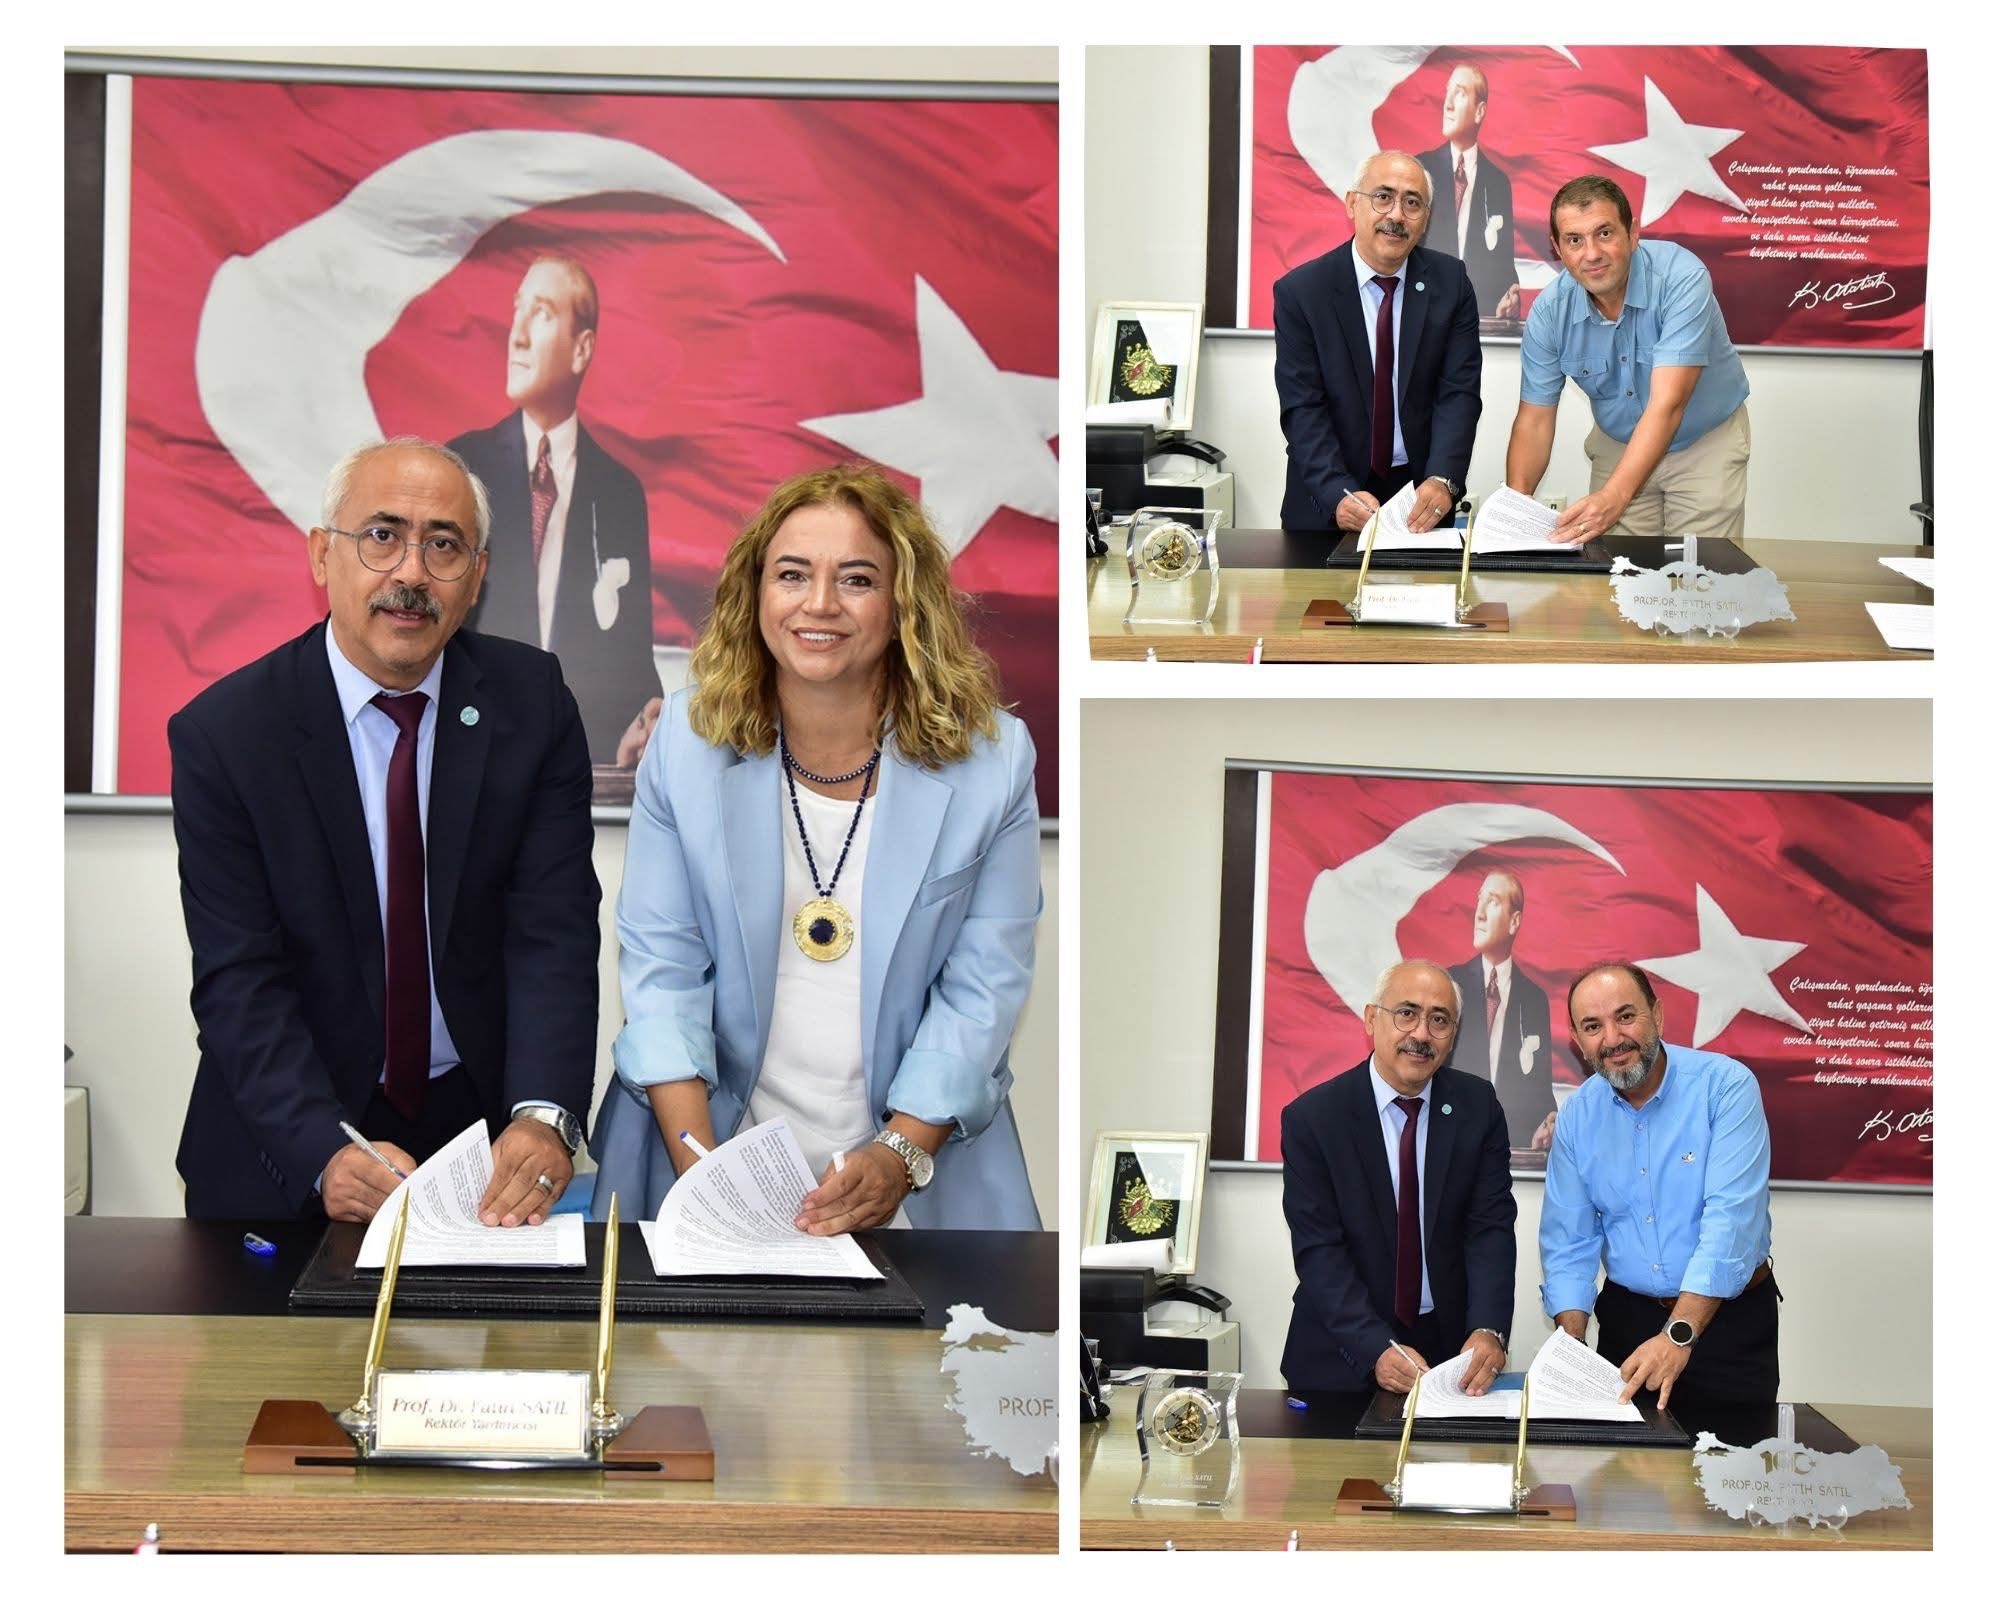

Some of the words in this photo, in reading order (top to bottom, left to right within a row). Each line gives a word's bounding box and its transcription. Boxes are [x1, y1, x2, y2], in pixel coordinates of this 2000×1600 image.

[1728, 161, 1784, 176] Çalışmadan,
[1787, 164, 1842, 176] yorulmadan,
[1845, 165, 1898, 178] öğrenmeden,
[1762, 180, 1787, 191] rahat
[1788, 182, 1822, 194] yaşama
[1744, 198, 1769, 209] itiyat
[1771, 196, 1798, 208] haline
[1799, 199, 1835, 211] getirmiş
[1812, 217, 1837, 226] sonra
[1750, 232, 1761, 241] ve
[1763, 231, 1785, 241] daha
[1787, 233, 1811, 242] sonra
[1813, 231, 1870, 244] istikballerini
[1749, 246, 1798, 260] kaybetmeye
[1790, 976, 1851, 992] Çalışmadan,
[1855, 980, 1914, 994] yorulmadan,
[1827, 998, 1854, 1009] rahat
[1856, 1001, 1893, 1013] yaşama
[1808, 1017, 1835, 1028] itiyat
[1837, 1016, 1867, 1029] haline
[1869, 1018, 1908, 1032] getirmiş
[1884, 1039, 1911, 1048] sonra
[1815, 1056, 1826, 1065] ve
[1829, 1053, 1853, 1065] daha
[1855, 1057, 1882, 1067] sonra
[1814, 1071, 1867, 1086] kaybetmeye
[392, 1398, 432, 1416] Prof.
[439, 1399, 463, 1414] Dr.
[1780, 1483, 1813, 1494] FTIH
